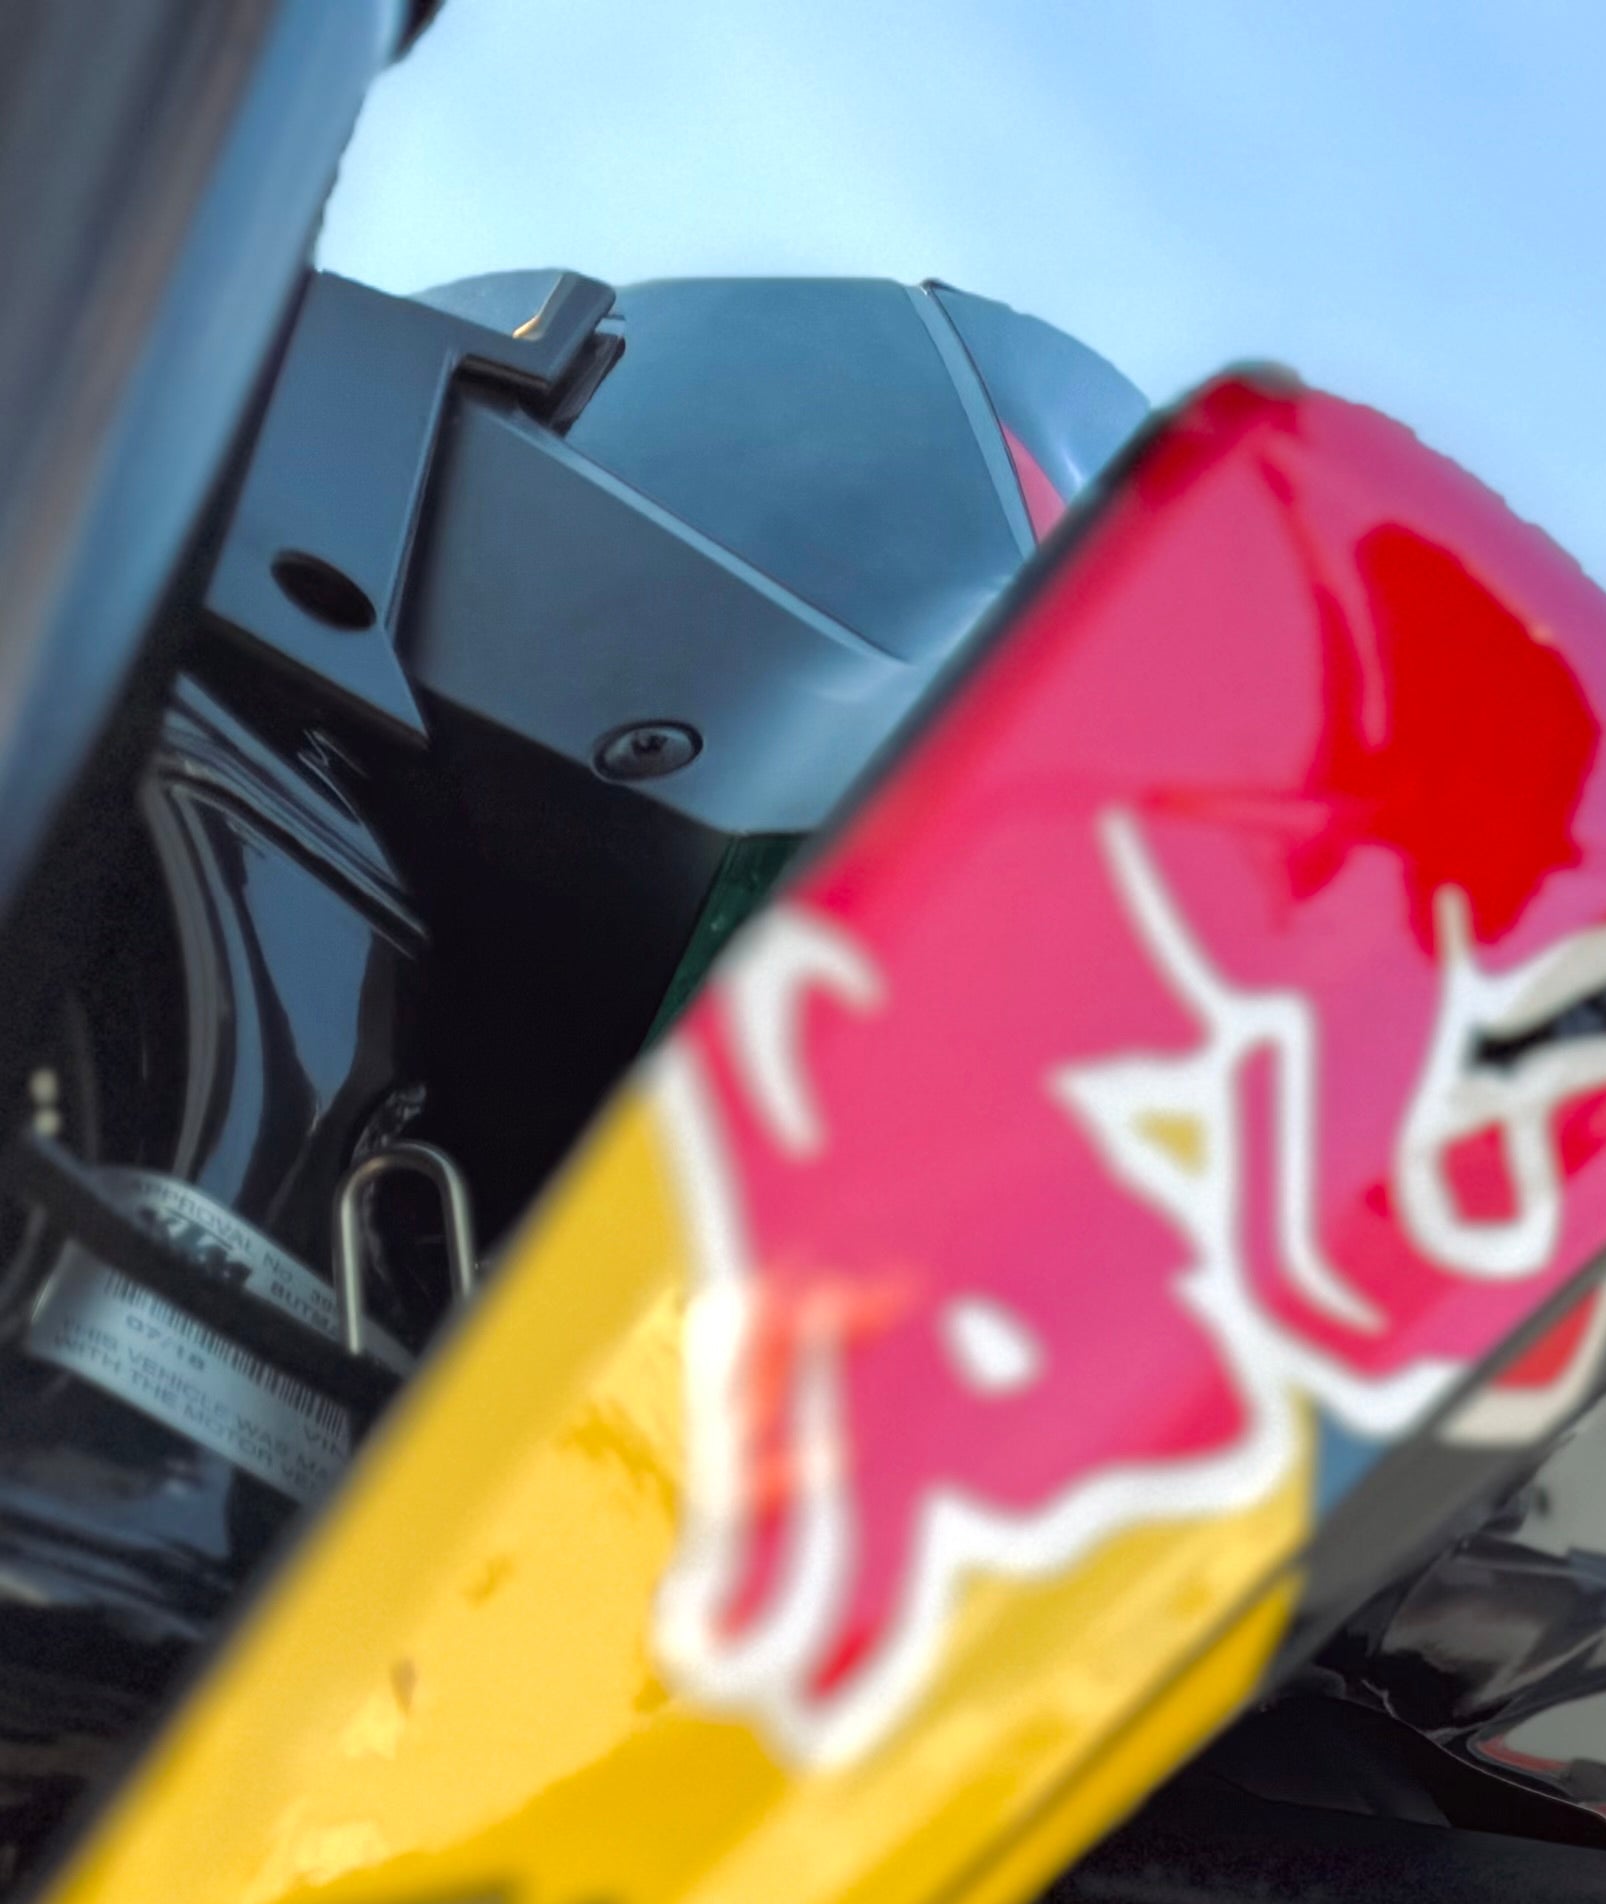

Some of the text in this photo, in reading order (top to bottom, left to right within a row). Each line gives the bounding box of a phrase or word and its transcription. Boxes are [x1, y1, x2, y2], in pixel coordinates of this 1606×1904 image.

[128, 1347, 229, 1418] VEHICLE
[236, 1413, 288, 1454] WAS
[131, 1368, 177, 1408] THE
[182, 1402, 273, 1468] MOTOR
